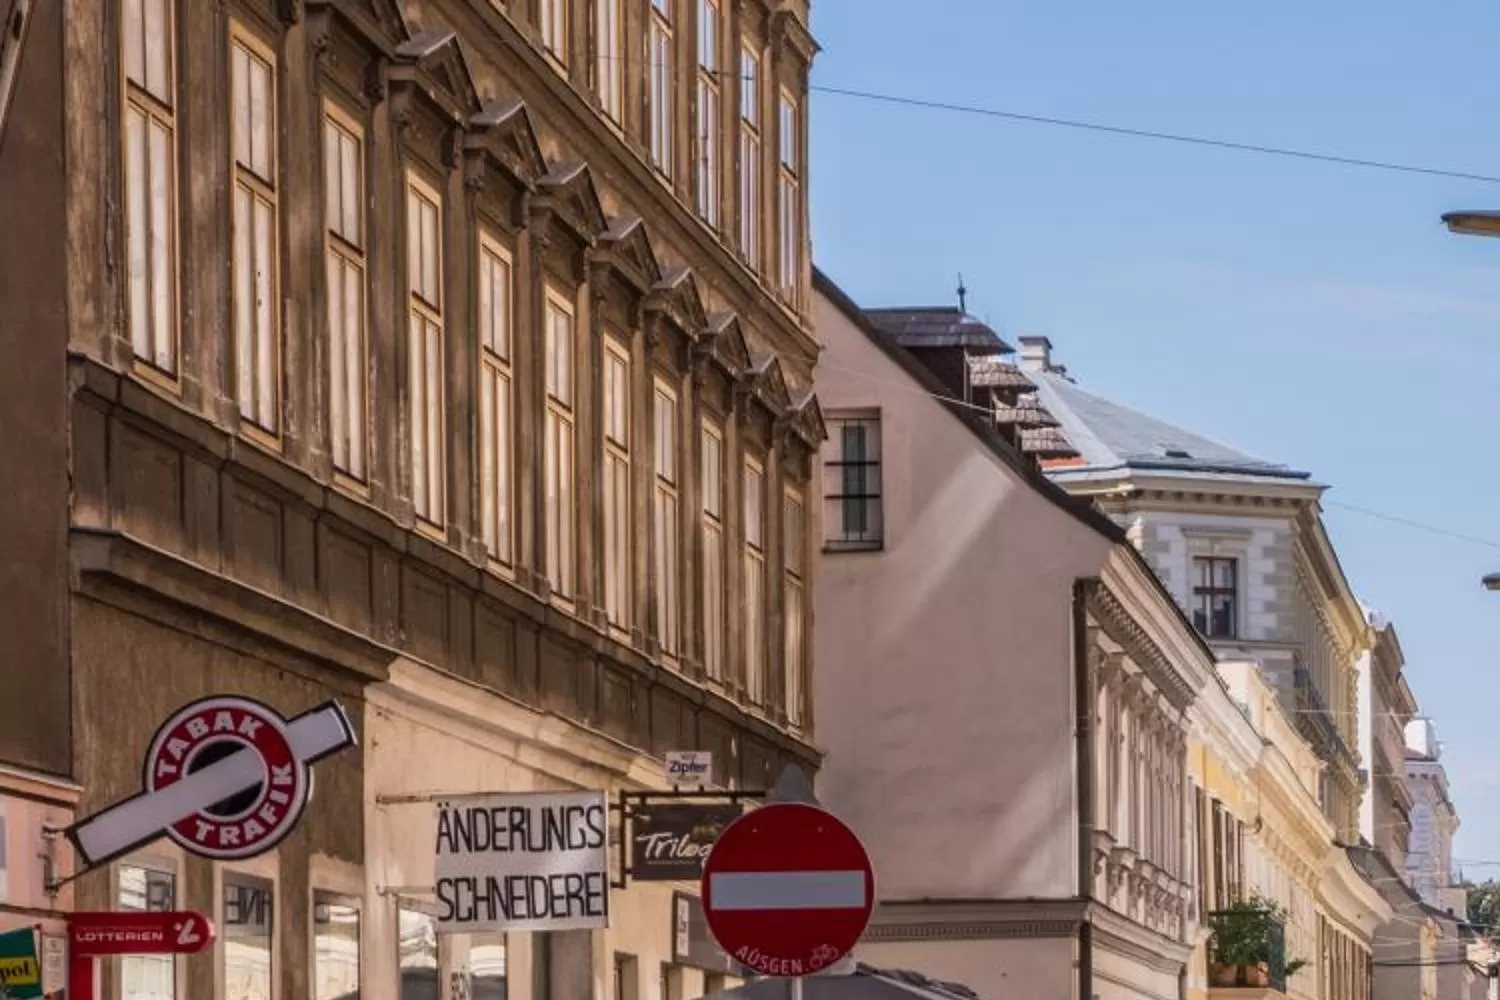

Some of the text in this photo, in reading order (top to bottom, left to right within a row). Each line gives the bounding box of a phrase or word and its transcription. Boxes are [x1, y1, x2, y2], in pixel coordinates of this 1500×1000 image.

[158, 711, 264, 778] TABAK
[669, 761, 707, 775] Zipfer
[195, 762, 293, 846] TRAFIK
[436, 802, 605, 854] ÄNDERUNGS
[436, 871, 608, 922] SCHNEIDEREI
[75, 931, 163, 942] LOTTERIEN
